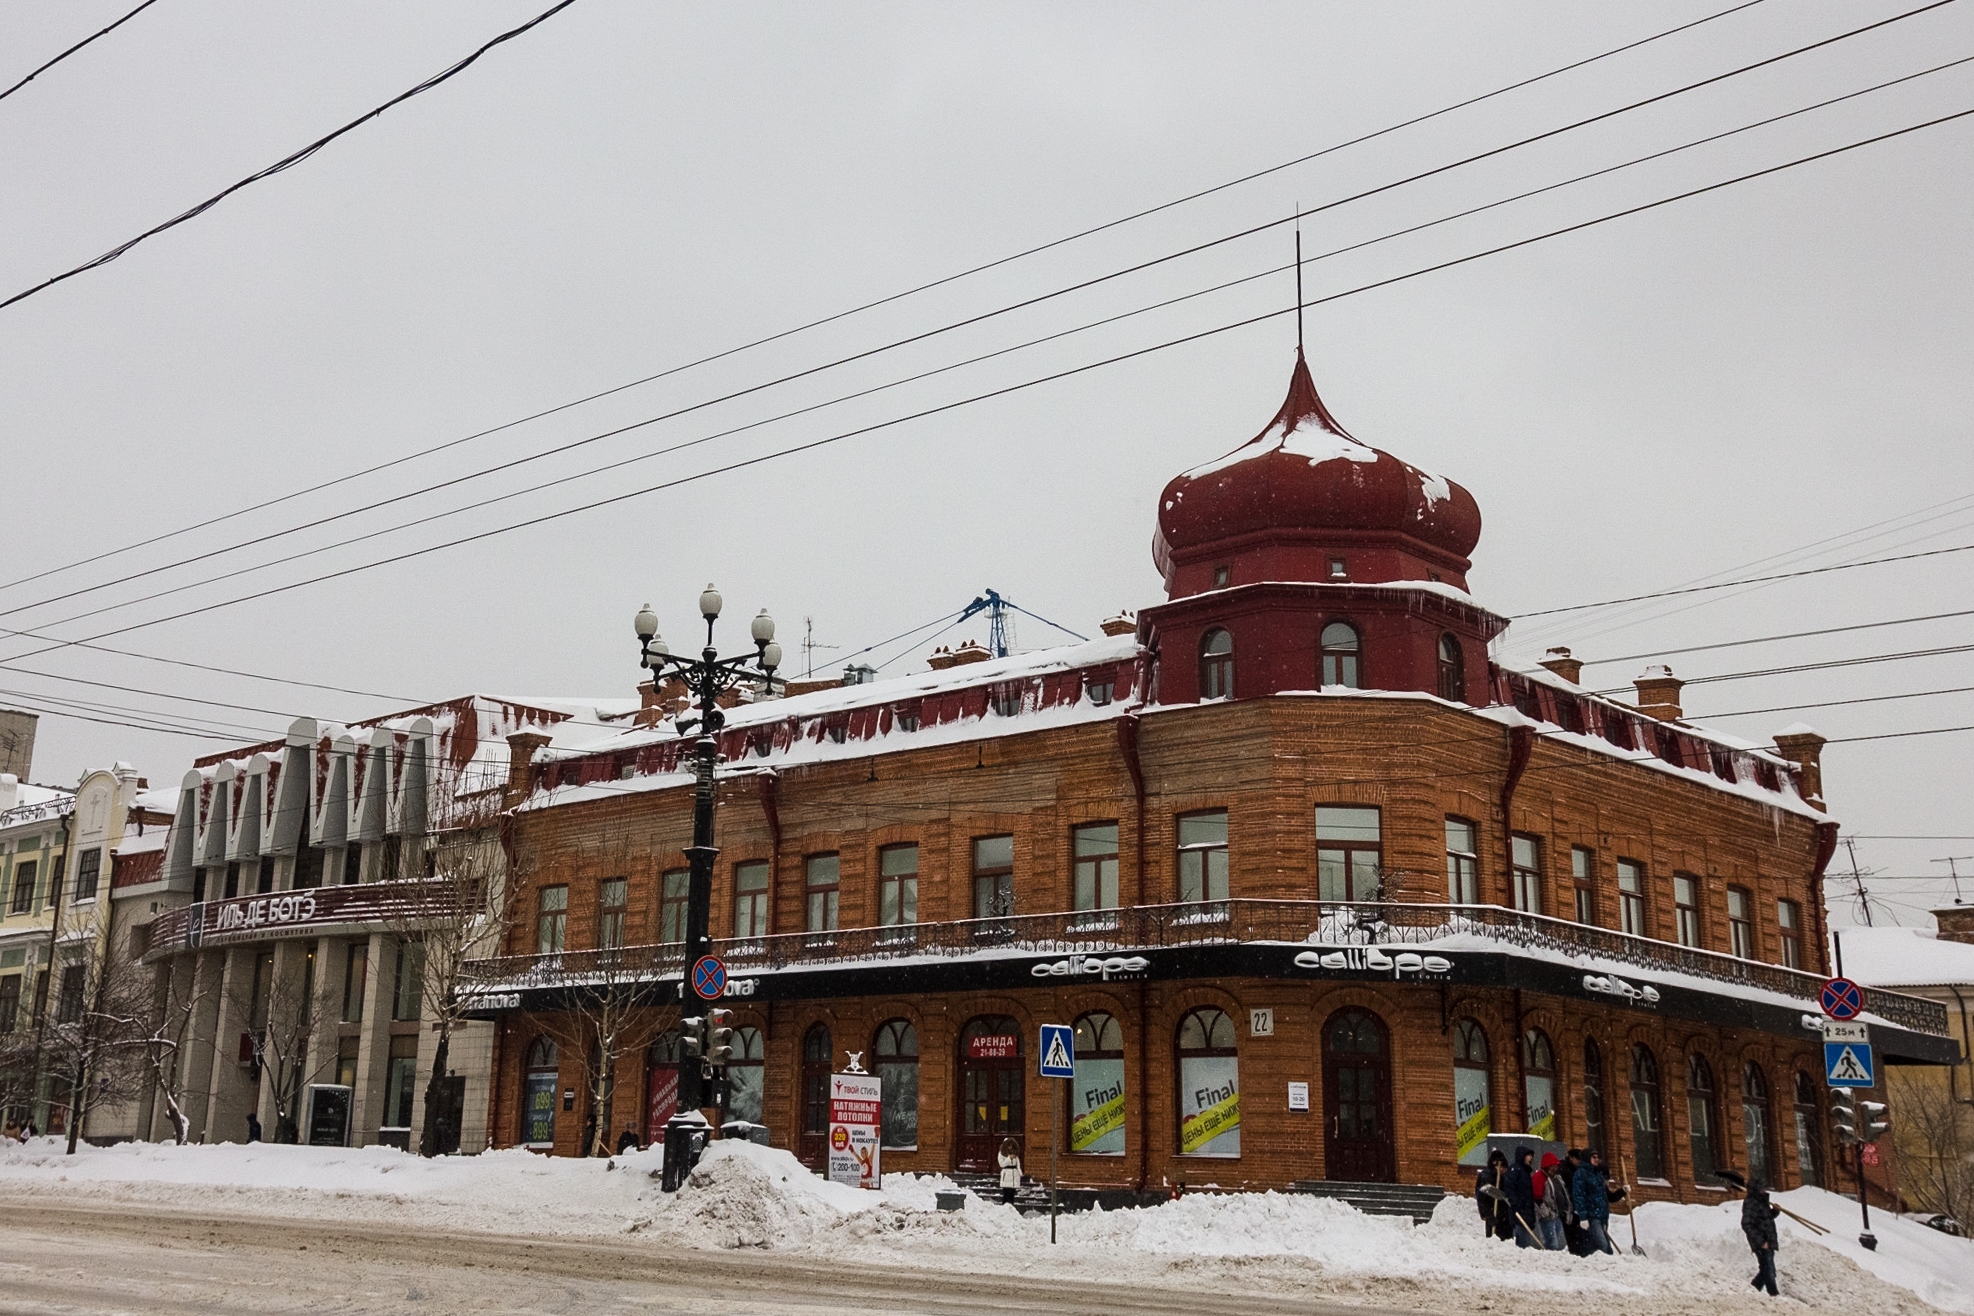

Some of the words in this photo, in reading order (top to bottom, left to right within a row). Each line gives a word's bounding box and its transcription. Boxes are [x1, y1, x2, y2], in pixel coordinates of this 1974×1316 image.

[217, 904, 244, 929] ИЛЬ
[244, 901, 267, 928] ДЕ
[1254, 1012, 1268, 1032] 22
[973, 1036, 1013, 1047] АРЕНДА
[844, 1085, 859, 1094] ТВОЙ
[860, 1086, 878, 1096] СТИЛЬ
[1085, 1080, 1122, 1109] Final
[1195, 1079, 1235, 1109] Final
[833, 1101, 877, 1113] НАТЯЖНЫЕ
[1457, 1092, 1484, 1119] Final
[837, 1111, 873, 1123] ПОТОЛКИ
[1073, 1123, 1093, 1144] ЦЕНЫ
[1182, 1125, 1204, 1145] ЦЕНЫ
[1203, 1111, 1222, 1131] ЕЩЁ
